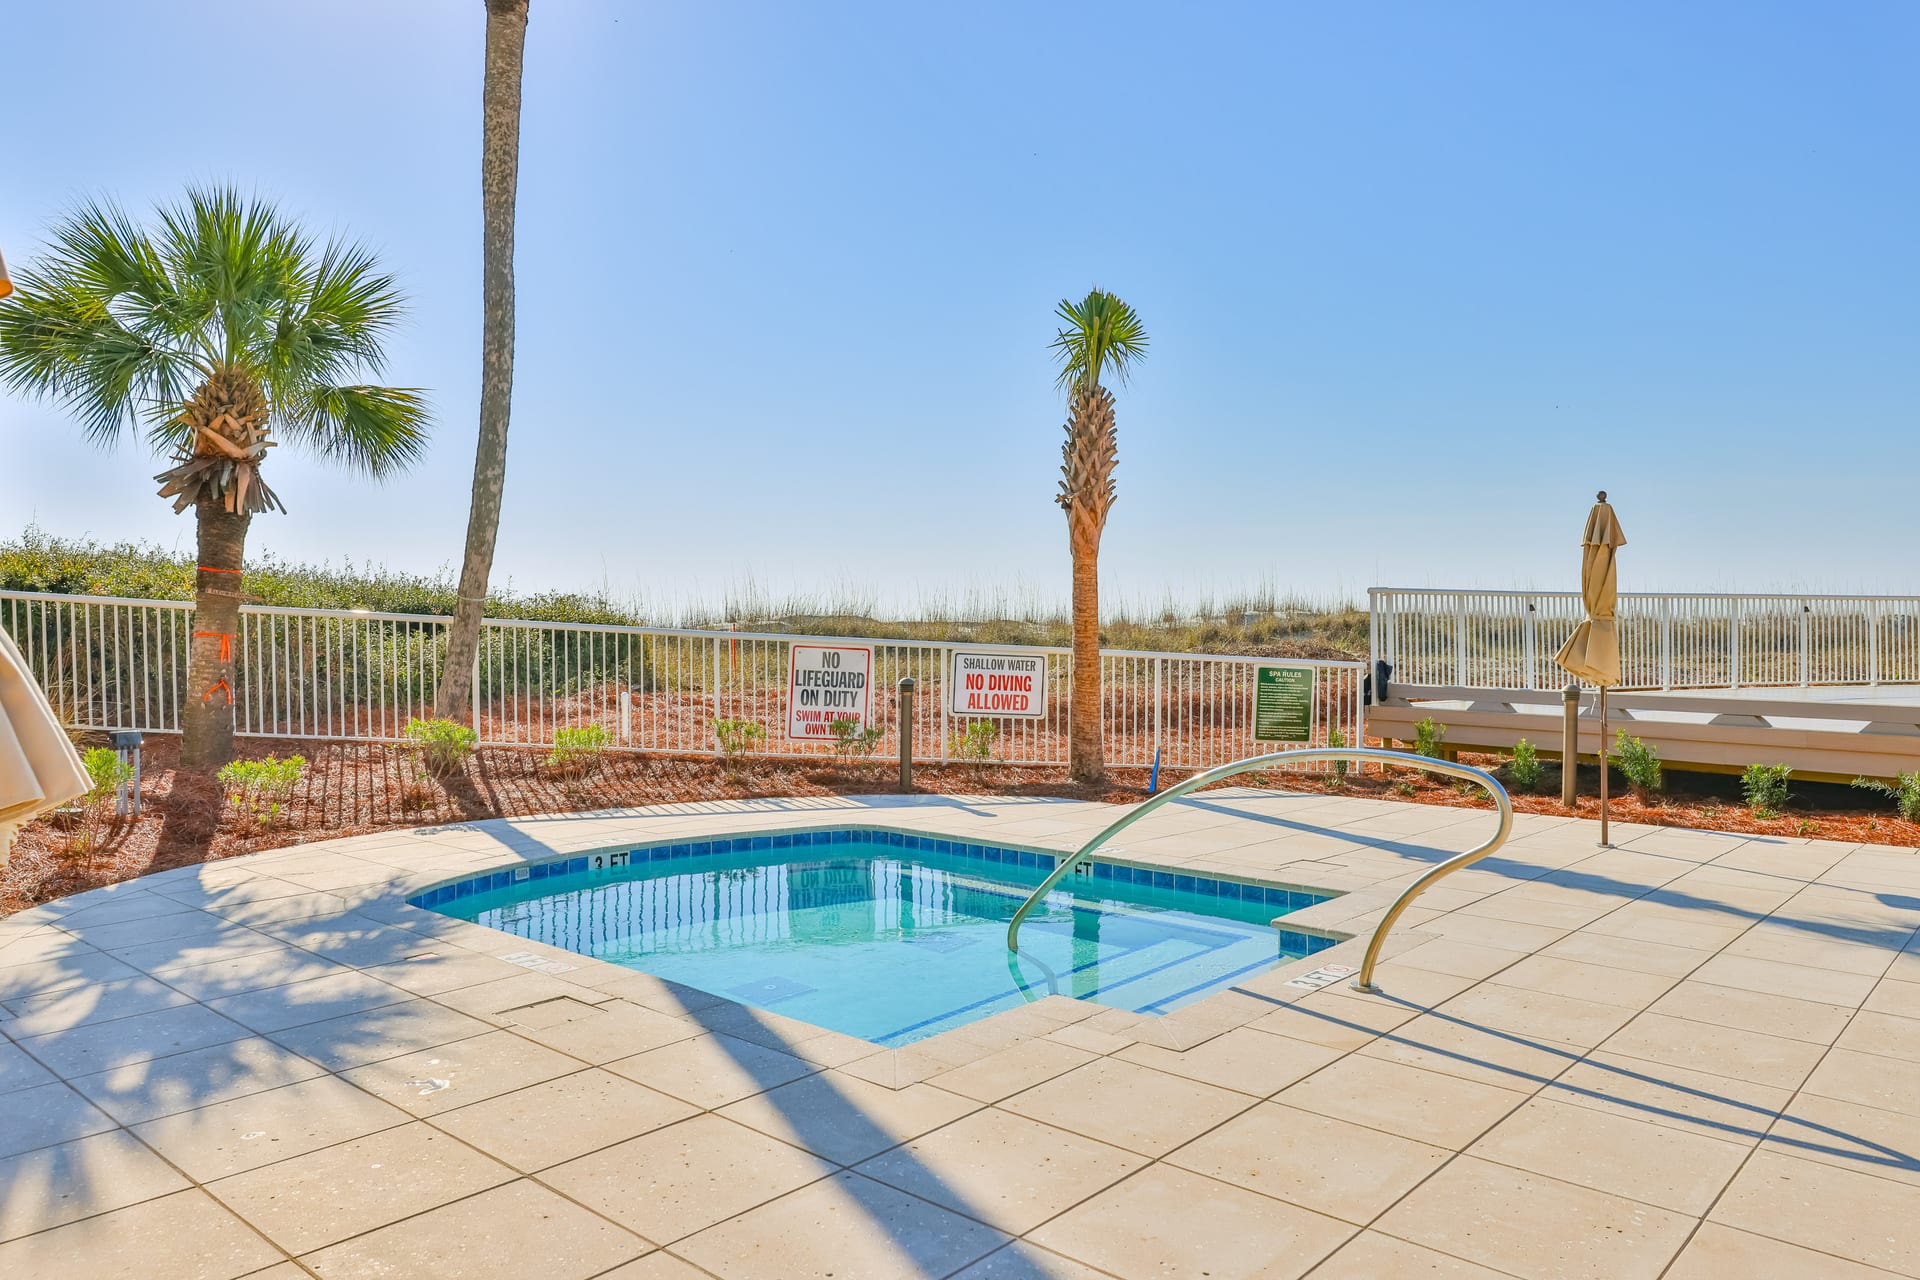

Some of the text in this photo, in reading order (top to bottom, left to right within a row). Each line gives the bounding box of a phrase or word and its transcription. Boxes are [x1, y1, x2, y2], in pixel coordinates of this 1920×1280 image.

[822, 651, 840, 669] NO
[963, 657, 1036, 672] SHALLOW WATER
[795, 669, 865, 689] LIFEGUARD
[965, 673, 1032, 692] NO DIVING
[800, 689, 858, 708] ON DUTY
[967, 692, 1029, 711] ALLOWED
[795, 710, 861, 724] SWIM AT YOUR
[805, 723, 826, 735] OWN
[595, 852, 629, 870] 3 FT
[1074, 861, 1092, 877] FT
[1304, 971, 1342, 982] FT
